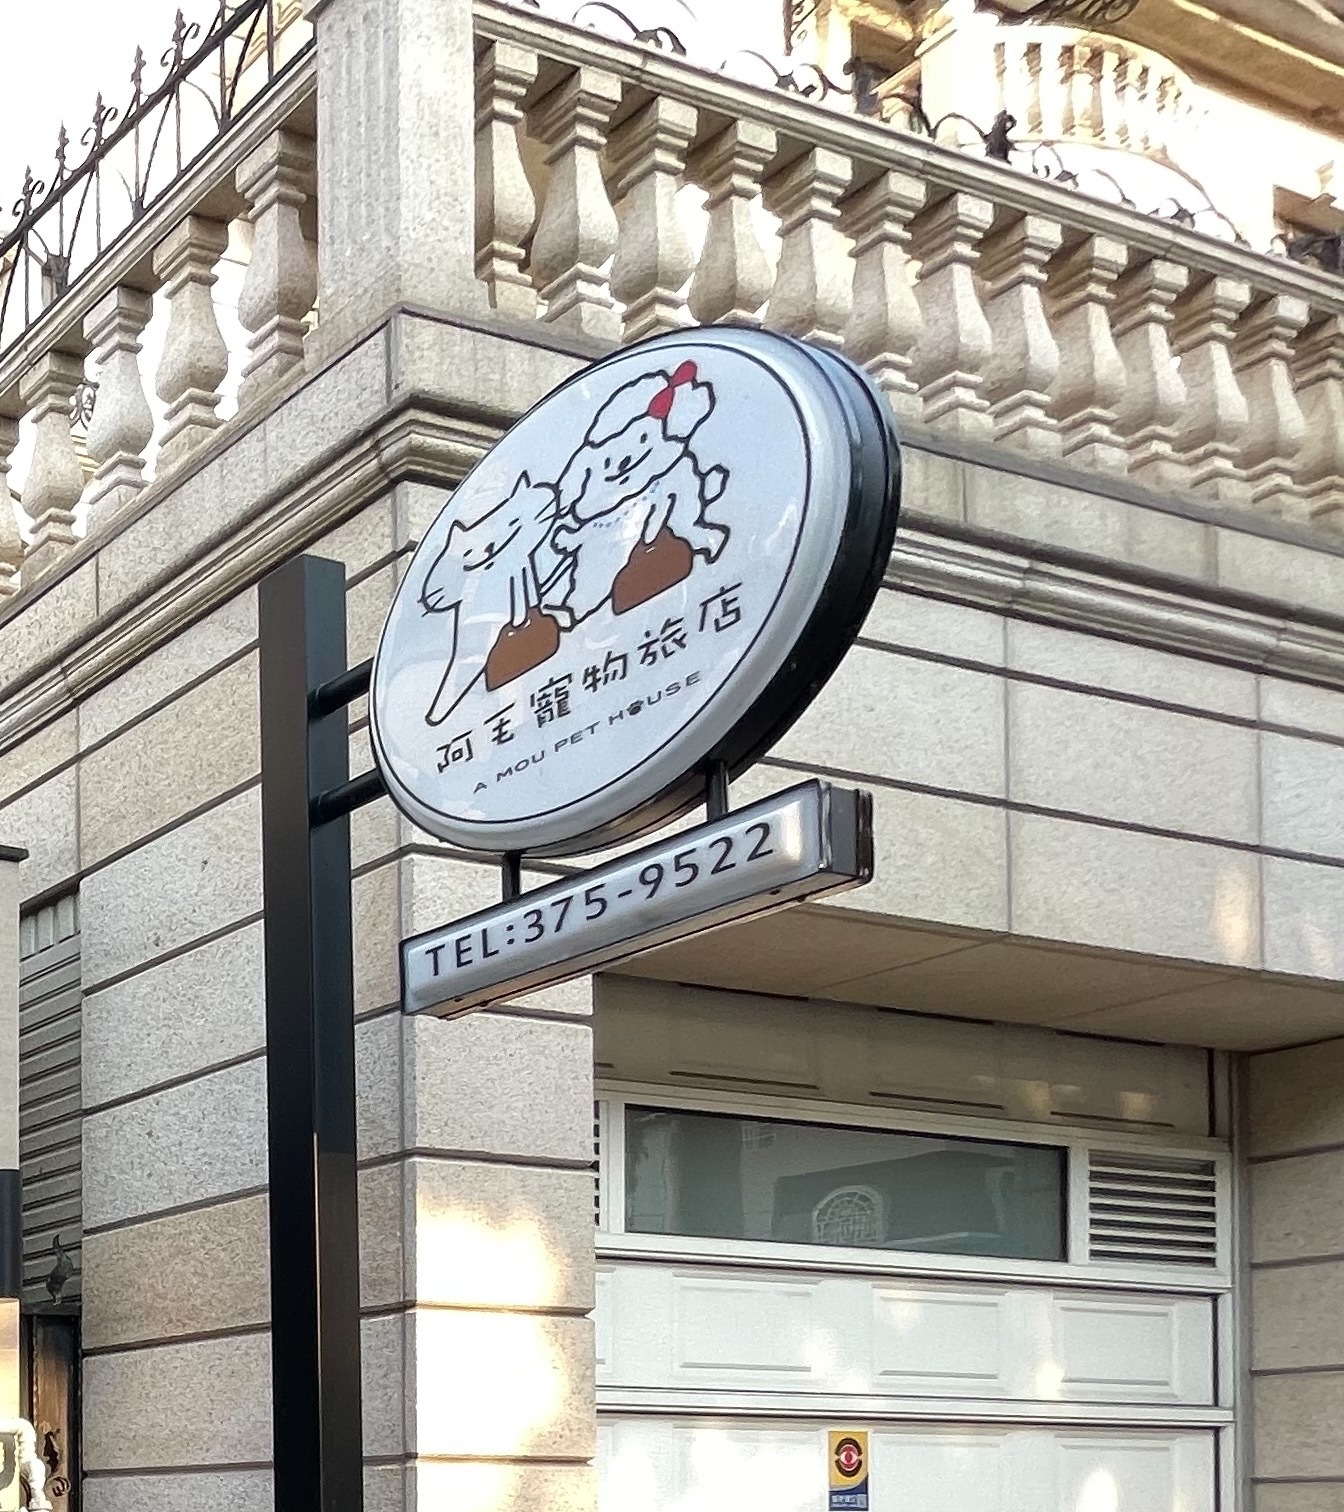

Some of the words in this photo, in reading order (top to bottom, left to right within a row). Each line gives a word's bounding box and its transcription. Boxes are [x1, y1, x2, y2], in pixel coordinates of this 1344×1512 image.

[436, 581, 745, 774] 阿毛寵物旅店
[473, 782, 488, 794] A
[496, 751, 546, 782] MOU
[554, 721, 601, 753] PET
[424, 822, 776, 978] TEL:375-9522
